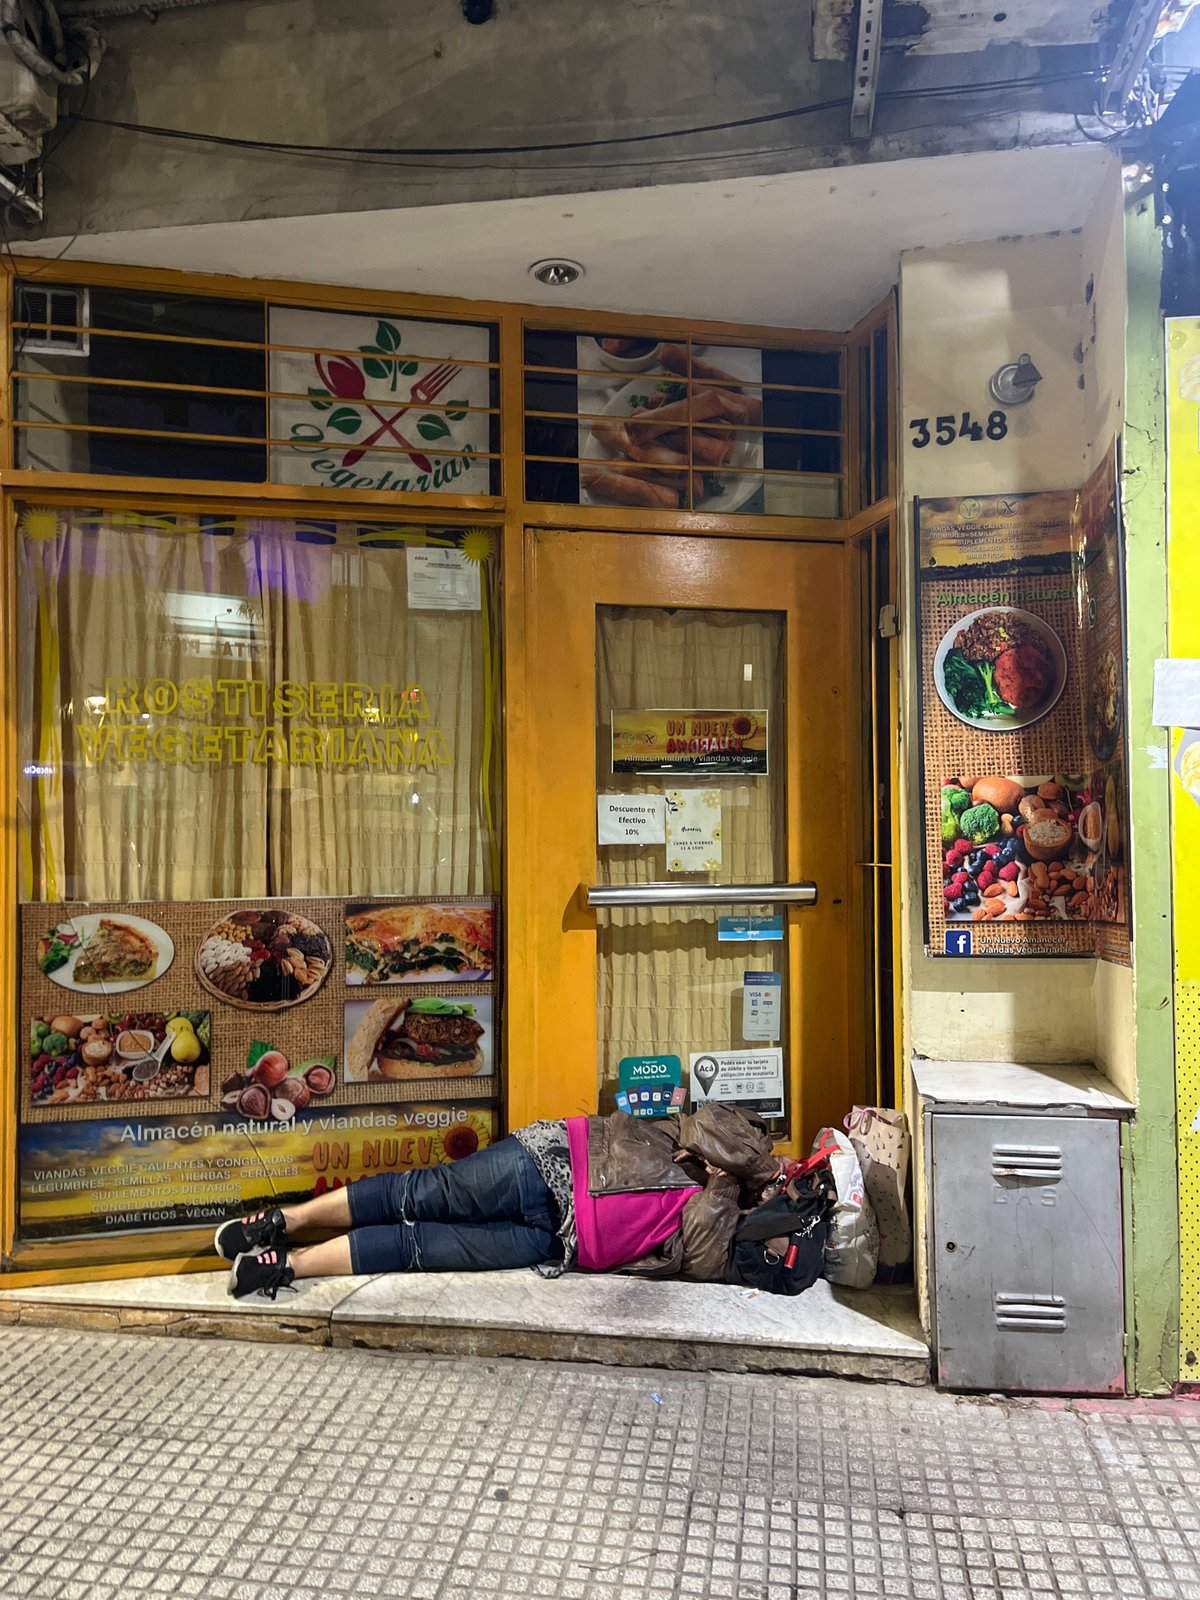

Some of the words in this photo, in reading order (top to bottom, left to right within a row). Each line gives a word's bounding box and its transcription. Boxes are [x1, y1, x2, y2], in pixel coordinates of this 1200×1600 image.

[909, 411, 1008, 448] 3548
[936, 588, 1010, 606] Almacén
[1015, 586, 1077, 601] natural
[104, 677, 431, 719] ROSTISERIA
[666, 720, 686, 736] UN
[77, 725, 454, 764] VEGETARIANA
[661, 754, 690, 762] natural
[690, 755, 697, 764] y
[699, 754, 730, 762] viandas
[609, 805, 645, 813] Descuento
[618, 816, 646, 824] Efectivo
[625, 828, 639, 836] 10%
[980, 936, 992, 944] Un
[994, 936, 1021, 944] Nuevo
[1022, 936, 1066, 944] Amanecer
[980, 946, 1014, 954] Viandas
[633, 1064, 667, 1075] MODO
[699, 1063, 714, 1073] Acá
[120, 1121, 216, 1143] Almacén
[222, 1116, 296, 1136] natural
[302, 1117, 313, 1136] y
[319, 1111, 398, 1131] viandas
[403, 1107, 468, 1127] veggie
[312, 1141, 350, 1171] UN
[33, 1167, 86, 1180] VIANDAS
[91, 1163, 136, 1176] VEGGIE
[139, 1159, 204, 1172] CALIENTES
[205, 1159, 214, 1168] Y
[216, 1155, 294, 1167] CONGELADAS
[31, 1180, 105, 1194] LEGUMBRES
[114, 1175, 171, 1186] SEMILLAS
[181, 1170, 231, 1182] HIERBAS
[240, 1167, 299, 1178] CEREALES
[91, 1186, 179, 1200] SUPLEMENTOS
[182, 1183, 242, 1194] DIETARIOS
[91, 1198, 175, 1213] CONGELADOS
[105, 1210, 177, 1224] DIABÉTICOS
[186, 1208, 226, 1218] VEGAN
